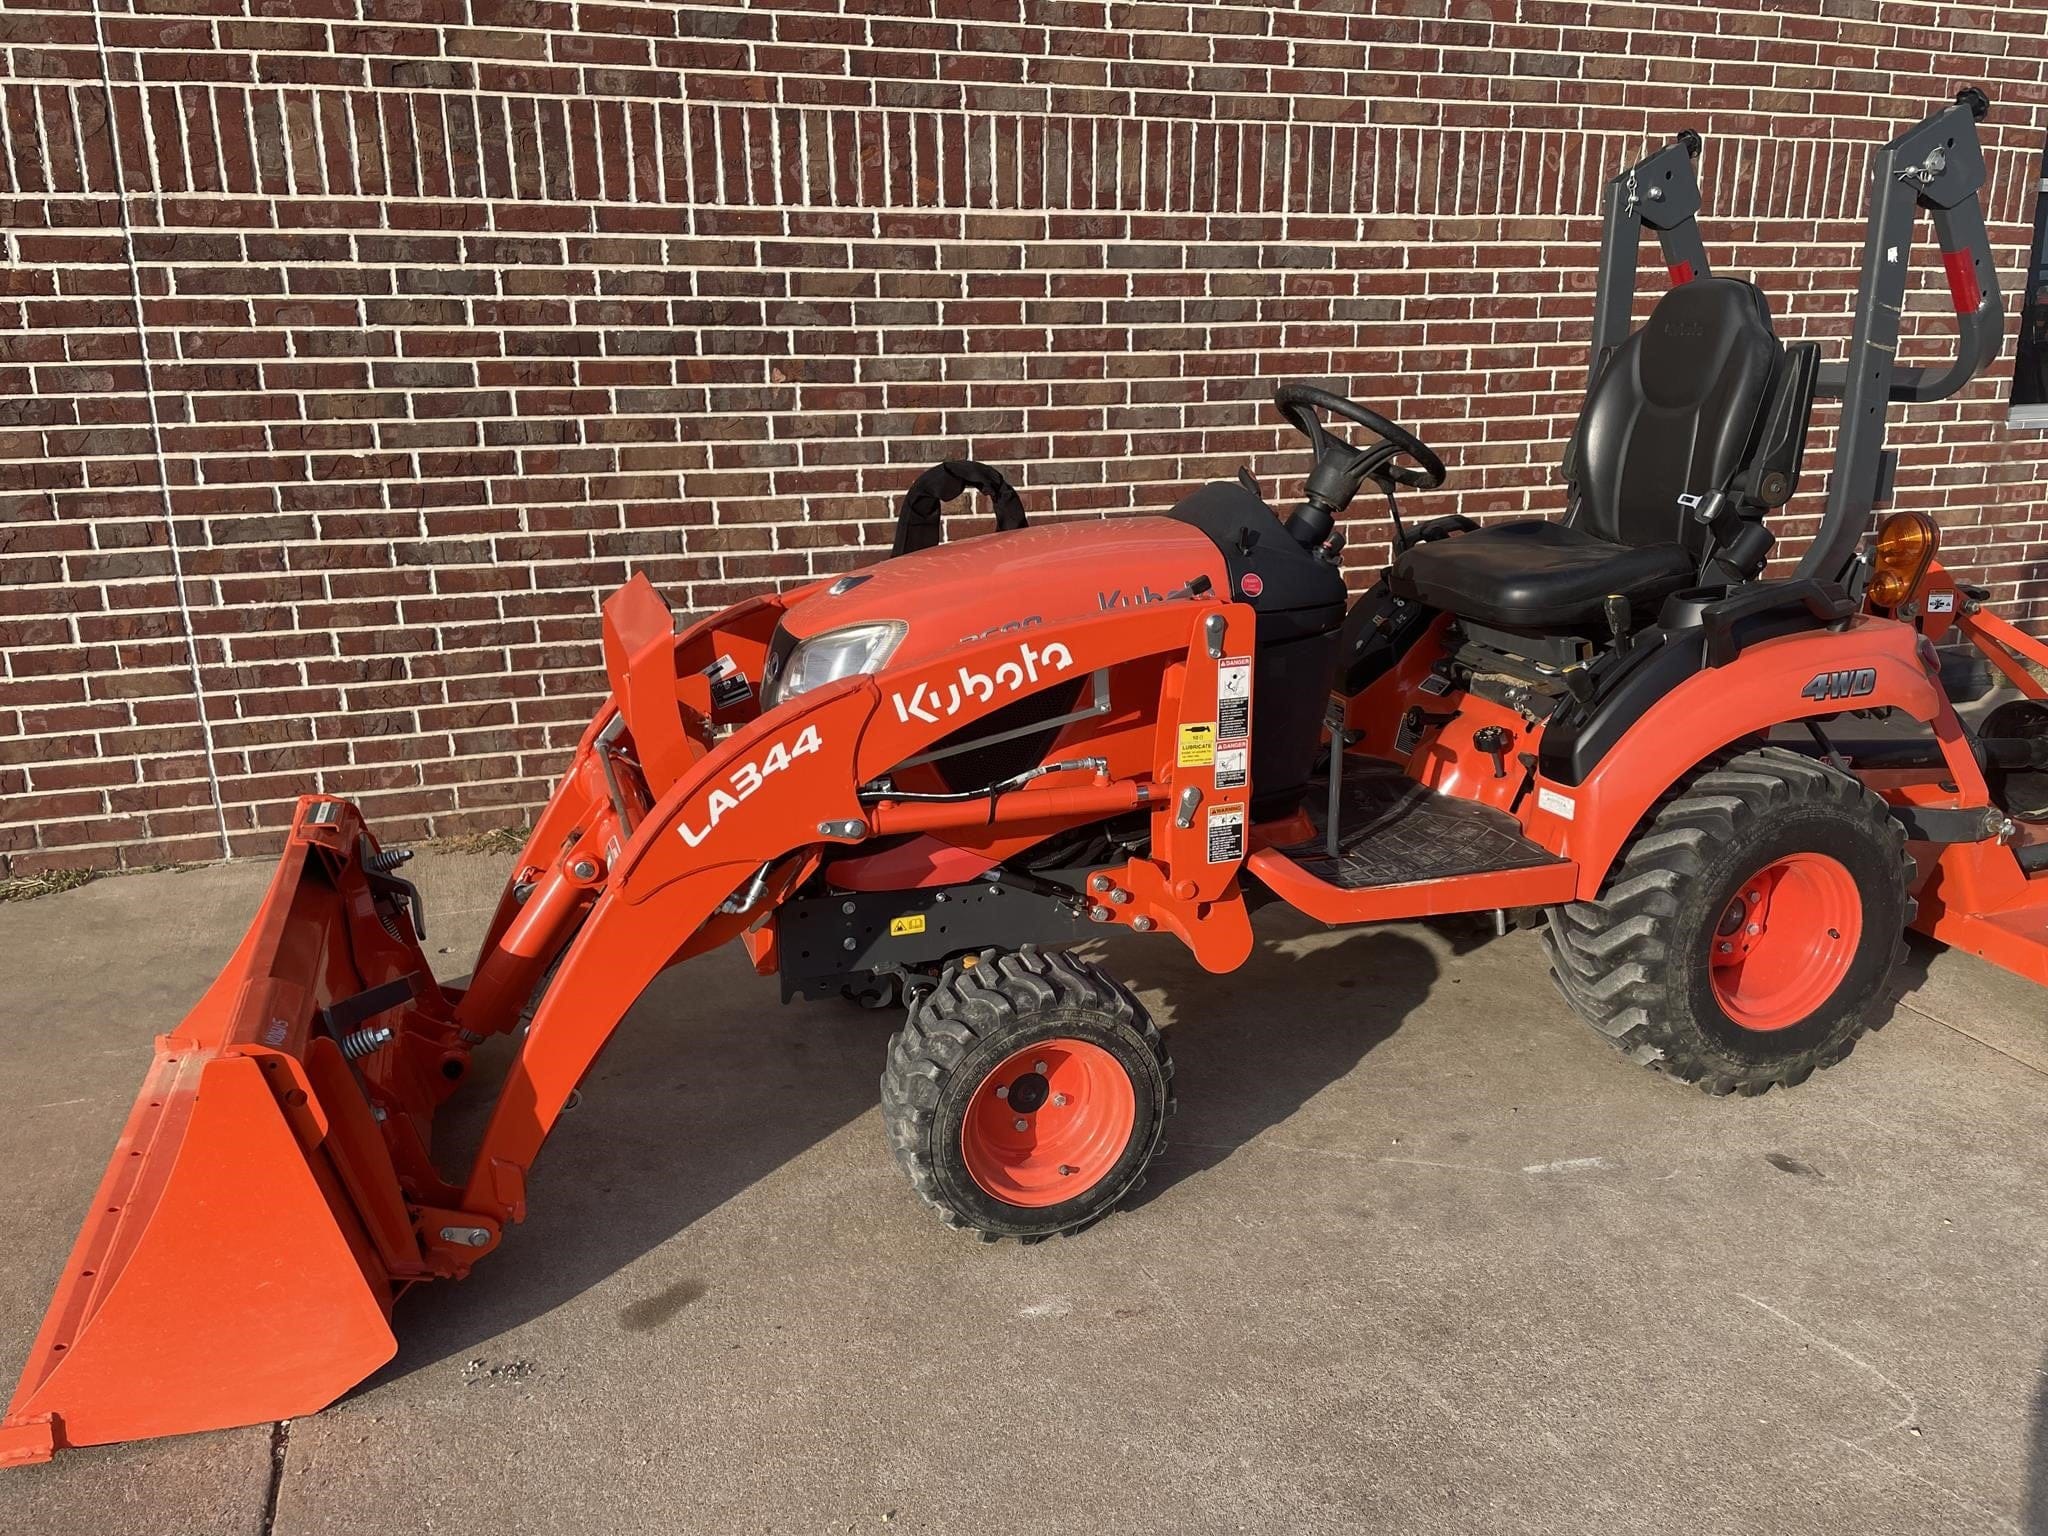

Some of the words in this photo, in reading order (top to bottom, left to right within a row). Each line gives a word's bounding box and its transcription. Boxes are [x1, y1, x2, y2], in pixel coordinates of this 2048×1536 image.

[892, 641, 1074, 724] Kubota
[1801, 668, 1876, 701] 4WD
[676, 724, 823, 848] LA344
